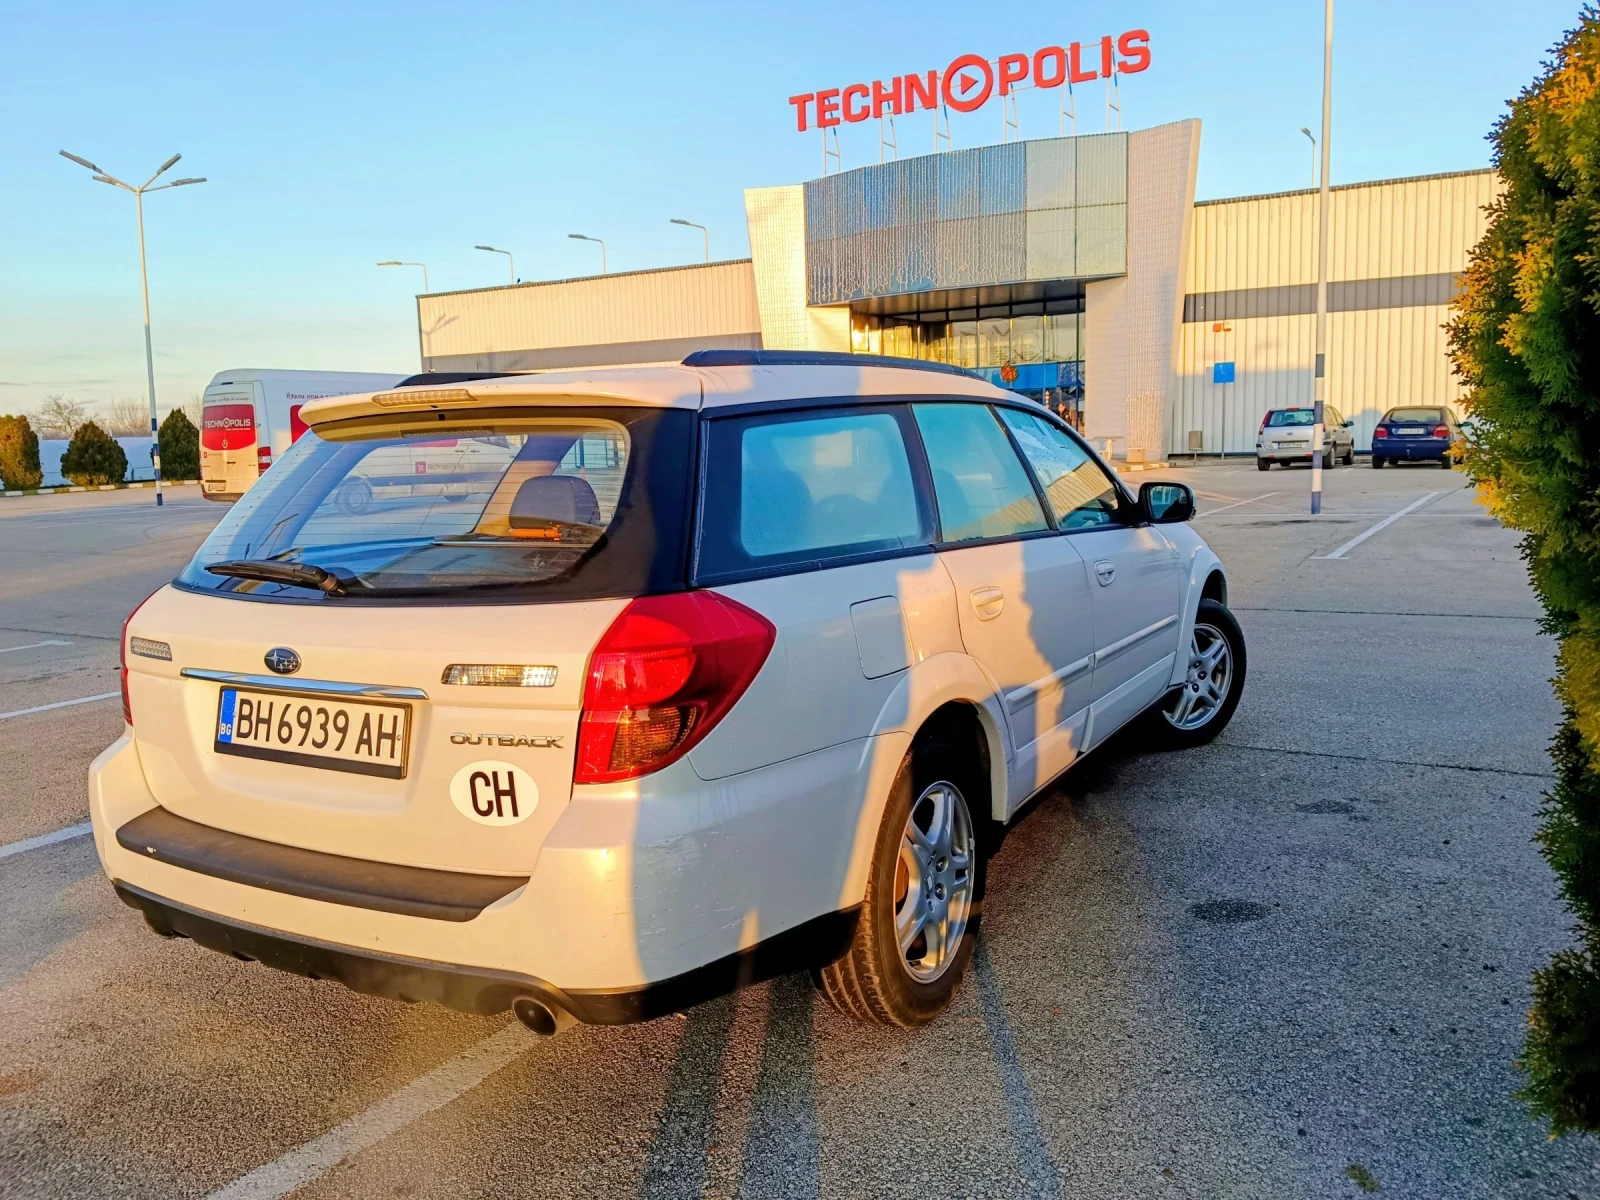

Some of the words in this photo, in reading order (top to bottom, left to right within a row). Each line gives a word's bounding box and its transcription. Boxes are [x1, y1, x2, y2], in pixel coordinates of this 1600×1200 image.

[788, 29, 1151, 132] TECHNOPOLIS
[204, 417, 251, 429] TECHNOPOLIS
[220, 723, 232, 736] BG
[236, 698, 274, 743] BH
[277, 703, 350, 752] 6939
[354, 712, 398, 759] AH
[450, 732, 565, 749] OUTBACK
[469, 771, 519, 818] CH
